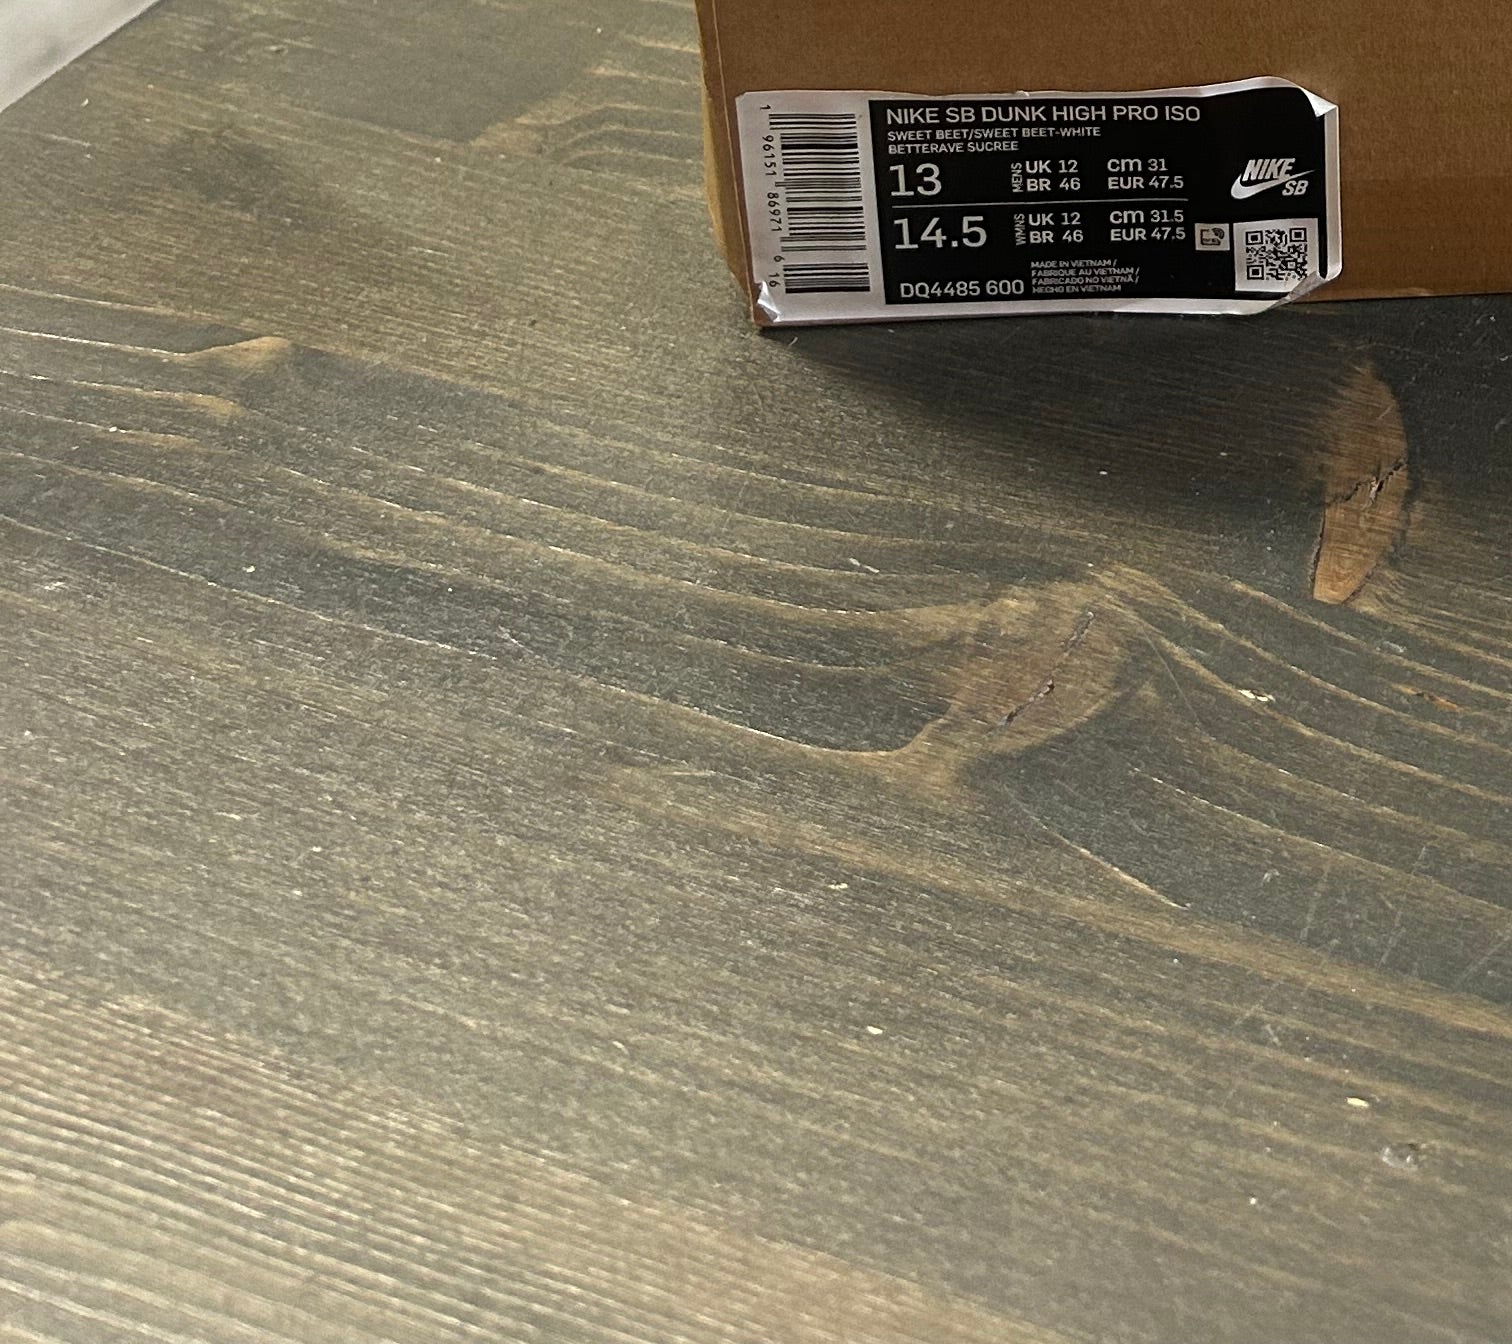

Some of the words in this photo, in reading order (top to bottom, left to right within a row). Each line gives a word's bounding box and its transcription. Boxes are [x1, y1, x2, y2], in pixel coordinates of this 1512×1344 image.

[886, 108, 940, 125] NIKE
[945, 107, 976, 123] SB
[981, 106, 1047, 122] DUNK
[1052, 105, 1106, 121] HIGH
[1113, 105, 1158, 121] PRO
[1165, 105, 1200, 121] ISO
[888, 130, 932, 141] SWEET
[935, 128, 1019, 140] BEET/SWEET
[1022, 127, 1101, 137] BEET-WHITE
[888, 142, 964, 154] BETTERAVE
[967, 141, 1019, 152] SUCREE
[1025, 160, 1052, 173] UK
[1058, 159, 1078, 173] 12
[1107, 158, 1142, 172] cm
[1147, 158, 1168, 171] 31
[1242, 158, 1296, 181] NIKE
[889, 163, 942, 196] 13
[1011, 162, 1024, 193] MENS
[1026, 178, 1051, 191] BR
[1059, 177, 1081, 190] 46
[1107, 176, 1144, 189] EUR
[1149, 175, 1184, 189] 47.5
[1282, 180, 1309, 196] SB
[1028, 213, 1054, 226] UK
[1061, 212, 1081, 225] 12
[1109, 210, 1145, 224] cm
[1150, 209, 1184, 223] 31.5
[894, 216, 987, 249] 14.5
[1014, 213, 1026, 246] WMNS
[1029, 231, 1054, 244] BR
[1062, 229, 1083, 243] 46
[1110, 228, 1147, 241] EUR
[1151, 227, 1186, 240] 47.5
[1059, 260, 1069, 268] IN
[1070, 259, 1112, 268] VIETNAM
[1031, 269, 1077, 277] FABRIQUE
[1095, 267, 1134, 276] VIETNAM
[1031, 276, 1084, 285] FABRICADO
[900, 281, 980, 299] DQ4485
[986, 279, 1025, 295] 600
[1032, 285, 1064, 294] HECHO
[1081, 284, 1122, 292] VIETNAM
